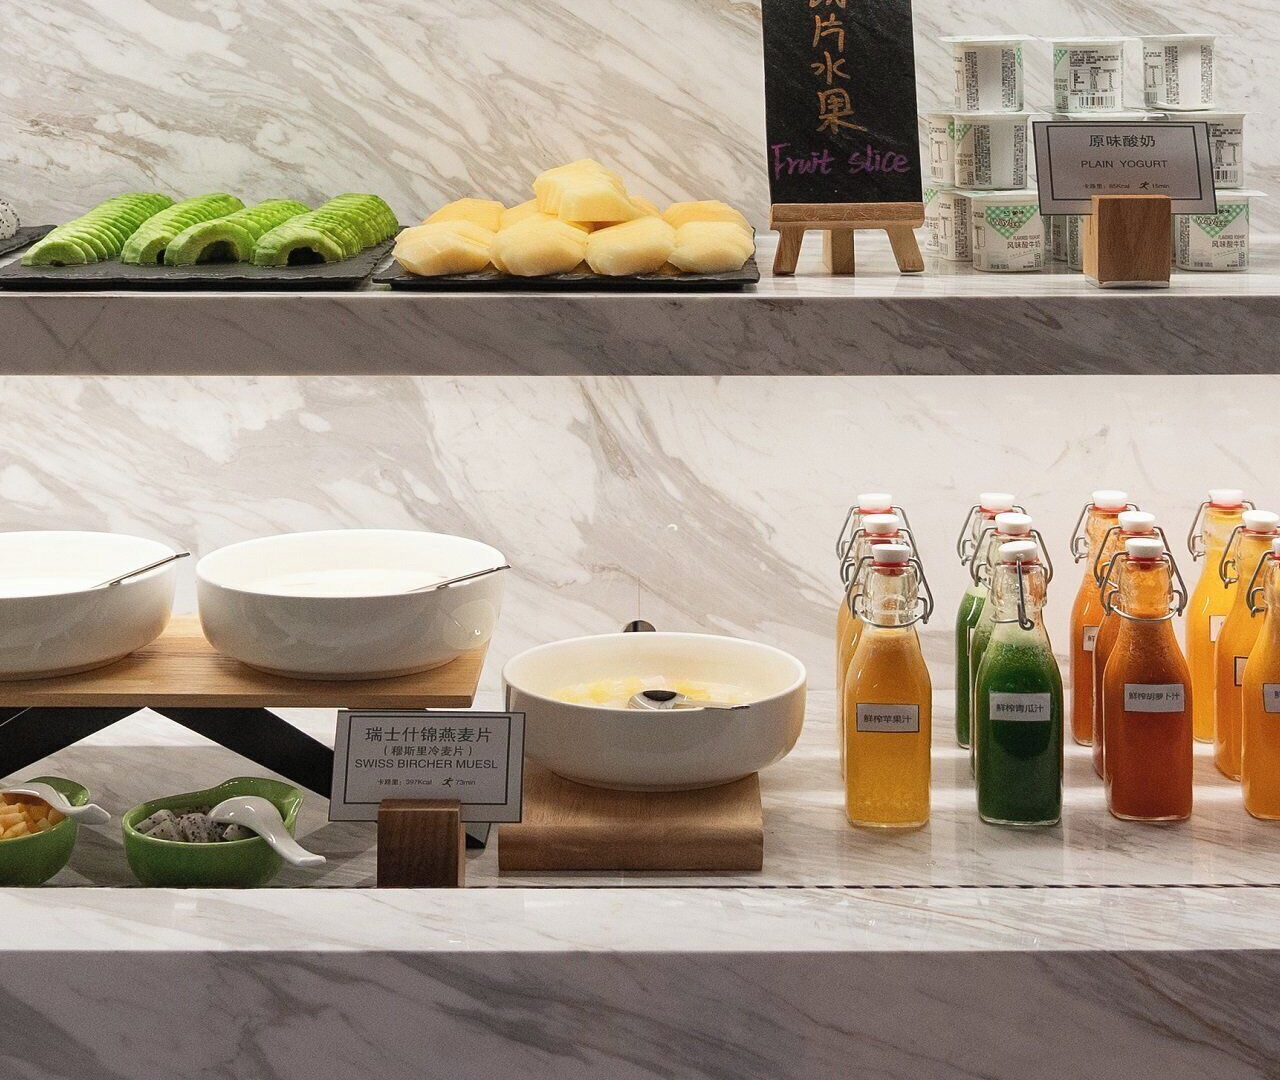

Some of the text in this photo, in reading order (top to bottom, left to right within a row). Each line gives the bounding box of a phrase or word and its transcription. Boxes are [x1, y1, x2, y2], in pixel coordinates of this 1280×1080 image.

[1088, 134, 1156, 148] 原味酸奶
[770, 143, 911, 180] Fruit slice
[1080, 159, 1168, 169] PLAIN YOGURT
[365, 726, 493, 743] 瑞士什锦燕麦片
[355, 759, 498, 769] SWISS BIRCHER MUESL
